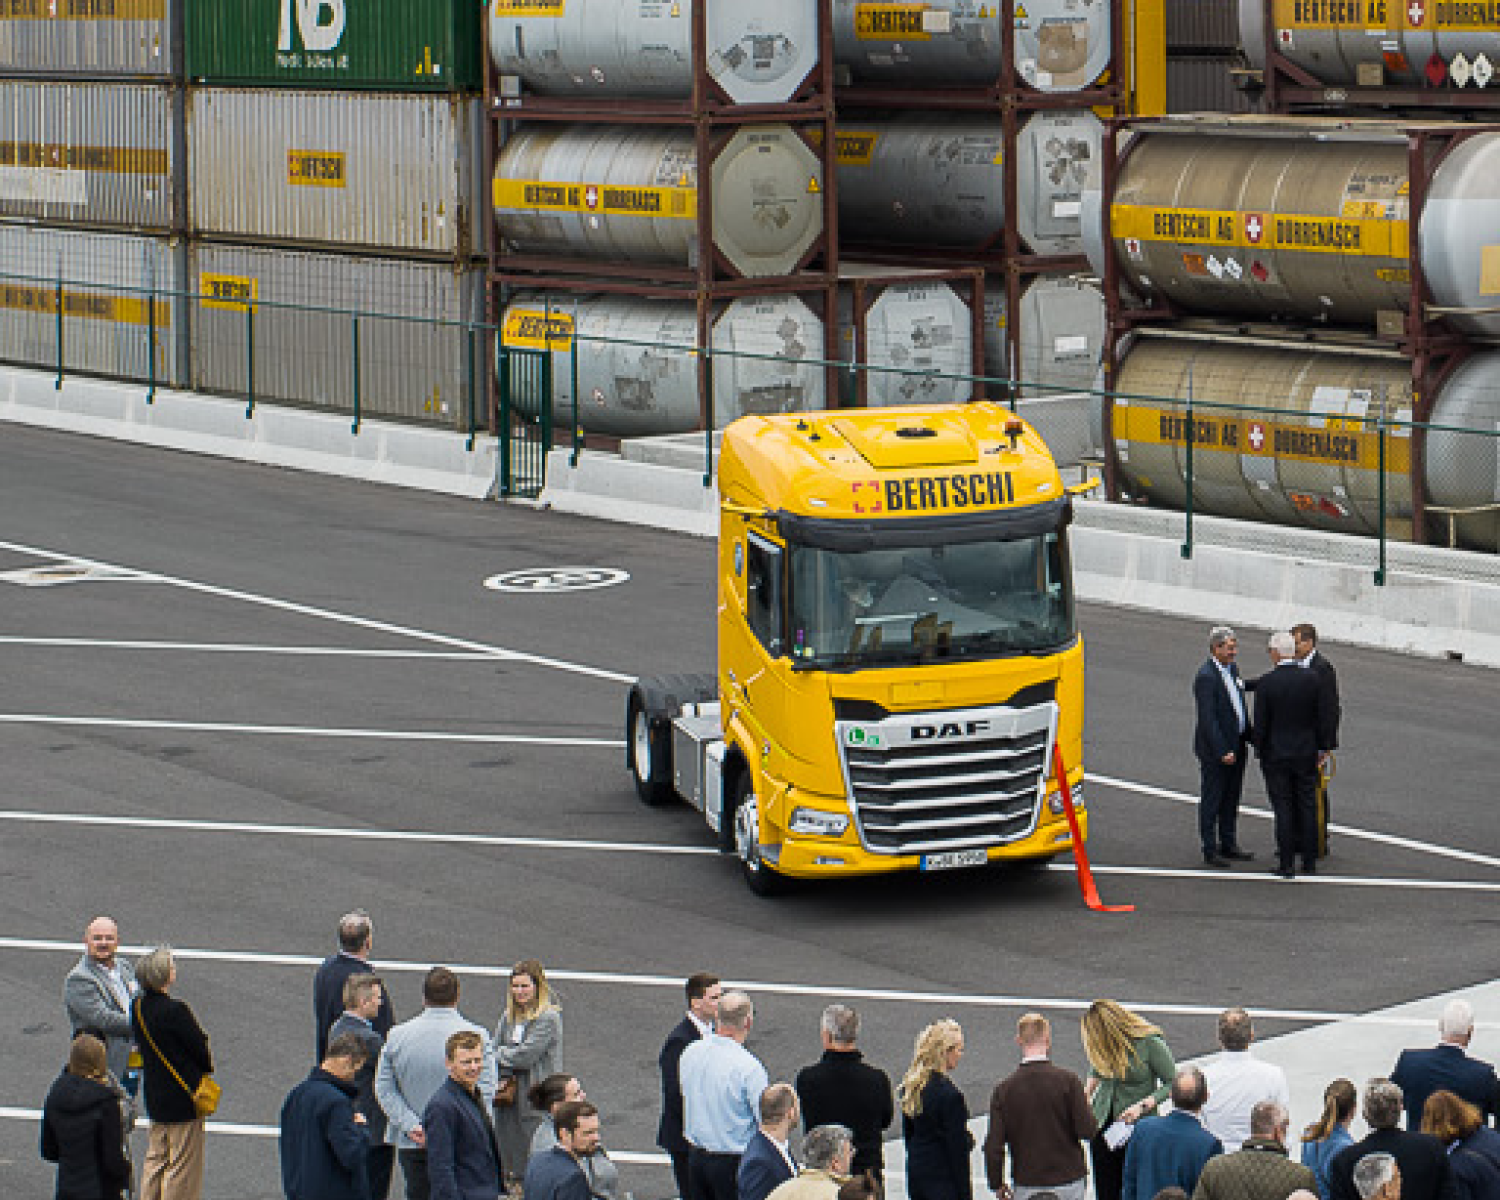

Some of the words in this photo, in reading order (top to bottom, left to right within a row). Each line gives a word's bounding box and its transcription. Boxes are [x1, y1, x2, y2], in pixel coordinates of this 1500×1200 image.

[871, 10, 922, 33] BERTSCH
[1294, 0, 1361, 24] BERTSCHI
[1367, 0, 1387, 24] AG
[1153, 212, 1211, 239] BERTSCHI
[1215, 215, 1233, 240] AG
[1218, 421, 1239, 448] AG
[885, 471, 1015, 511] BERTSCHI
[911, 720, 991, 741] DAF
